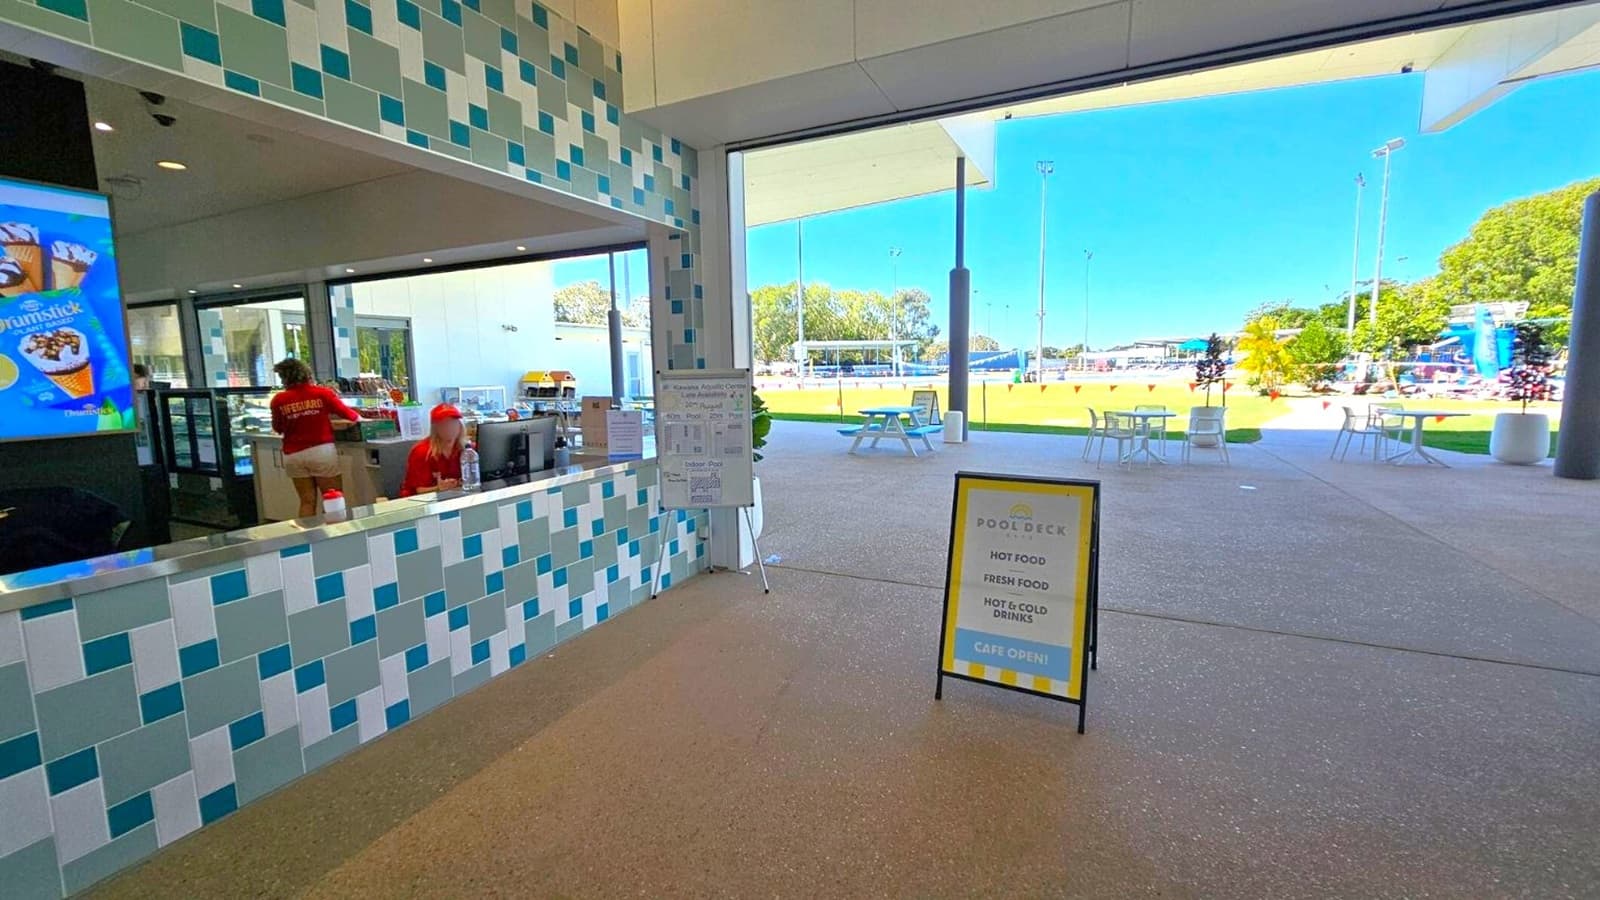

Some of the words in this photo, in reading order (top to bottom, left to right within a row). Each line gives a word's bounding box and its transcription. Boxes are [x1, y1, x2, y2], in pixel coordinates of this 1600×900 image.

[976, 517, 1018, 532] POOL
[1024, 522, 1067, 537] DECK
[990, 551, 1013, 562] HOT
[1014, 553, 1047, 566] FOOD
[983, 573, 1015, 586] FRESH
[1017, 578, 1050, 591] FOOD
[983, 597, 1007, 609] HOT
[1008, 601, 1017, 611] &
[1018, 603, 1048, 616] COLD
[993, 609, 1034, 624] DRINKS
[974, 641, 1005, 657] CAFE
[1007, 648, 1048, 665] OPEN!
